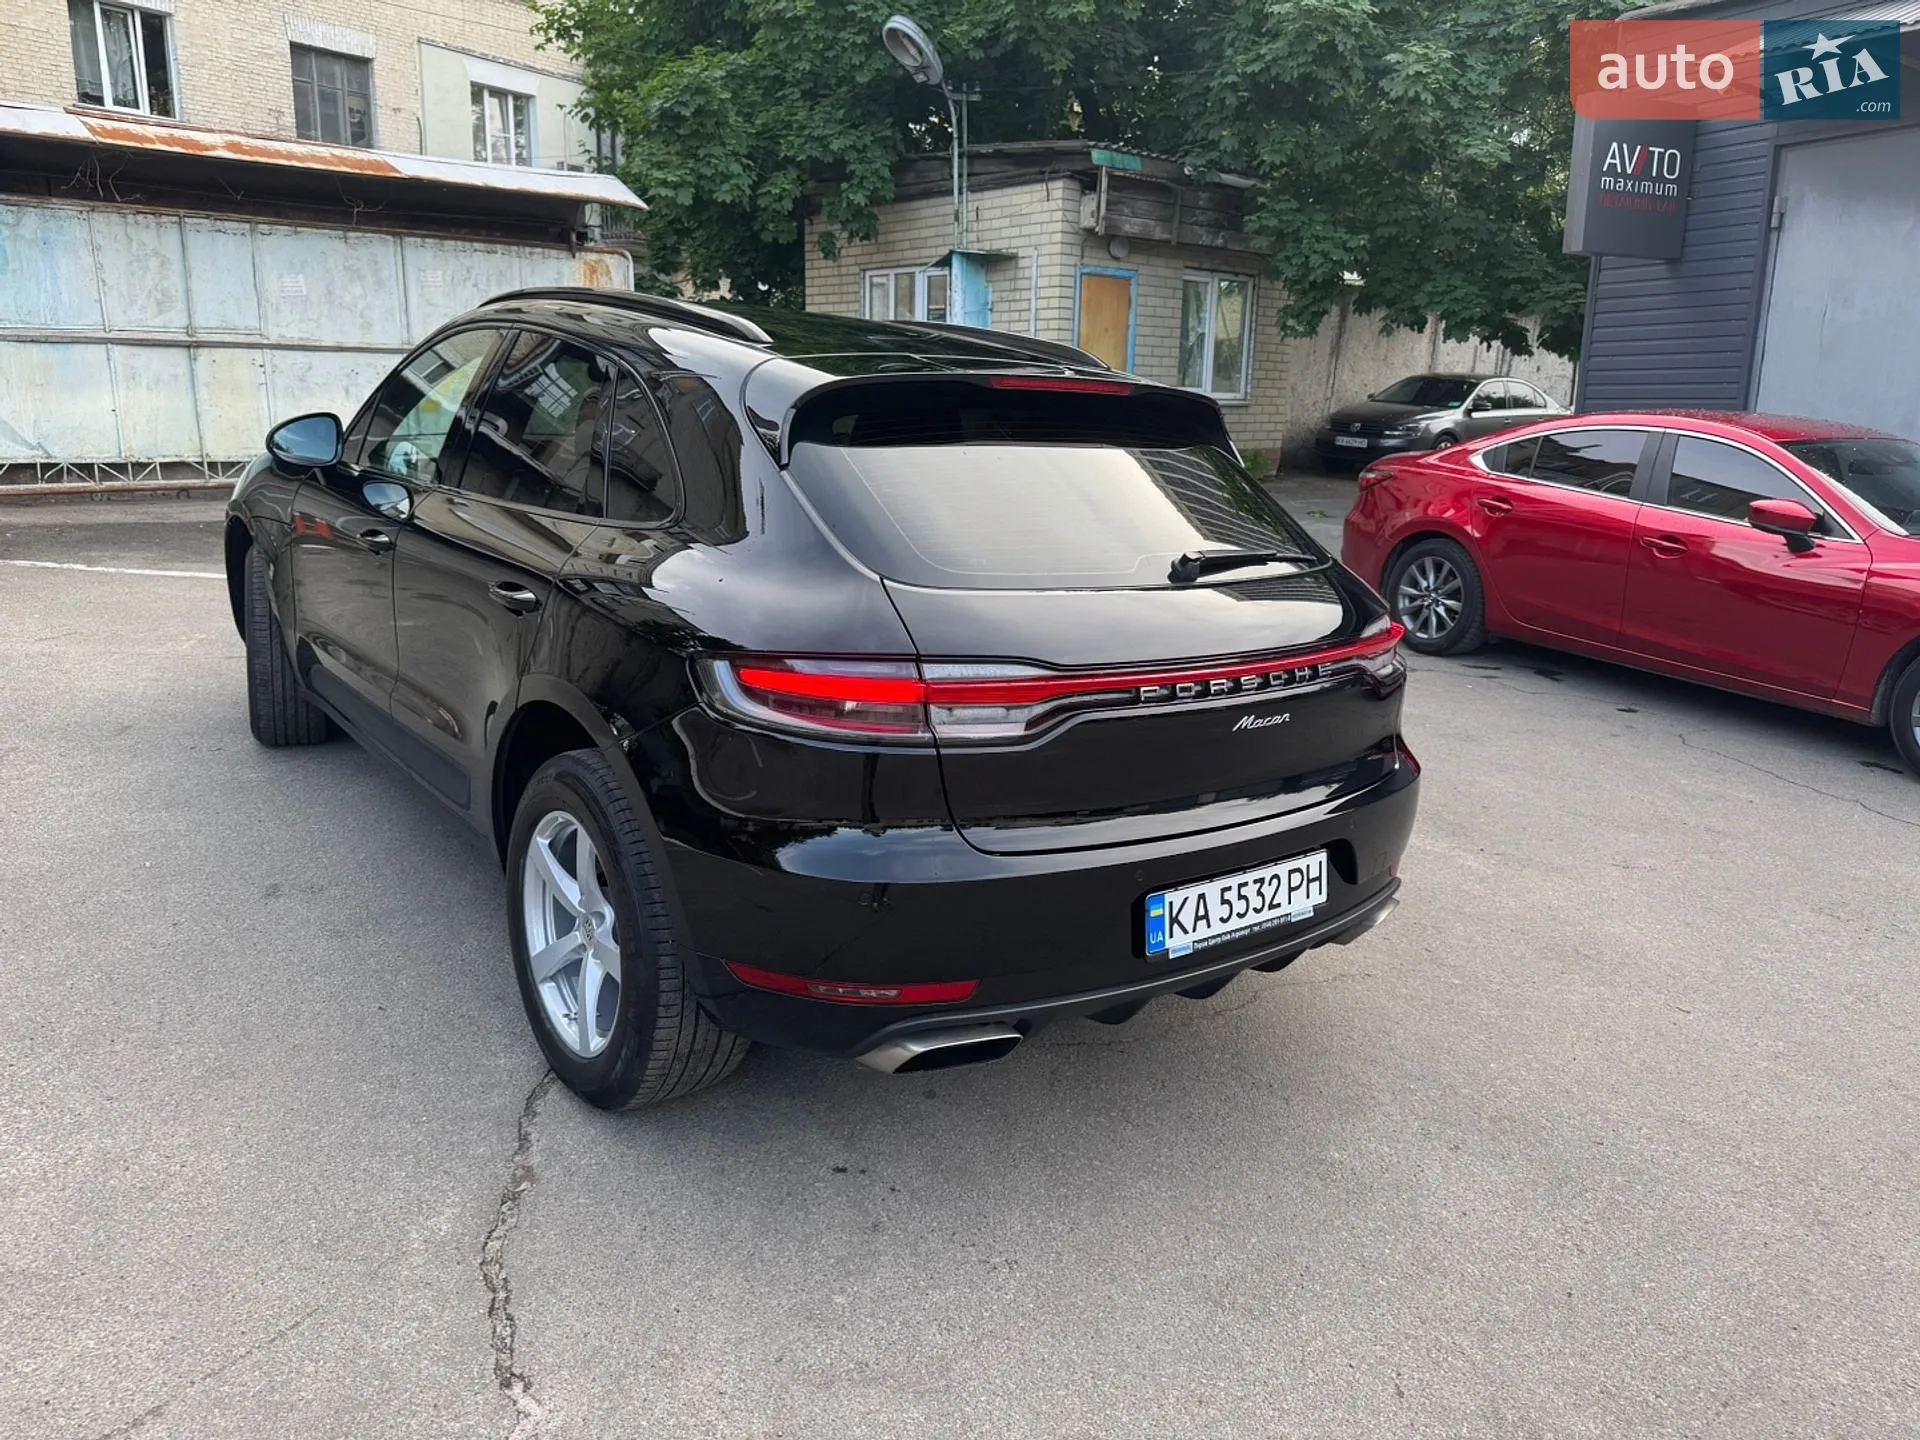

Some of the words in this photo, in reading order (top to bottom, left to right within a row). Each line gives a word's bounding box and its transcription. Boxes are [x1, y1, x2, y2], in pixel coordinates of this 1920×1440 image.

[1601, 177, 1678, 197] maximum
[1140, 663, 1334, 701] PORSCHE
[1232, 712, 1291, 732] Macan
[1168, 892, 1211, 939] KA
[1218, 873, 1282, 924] 5532
[1287, 860, 1323, 905] PH
[1150, 931, 1164, 945] UA
